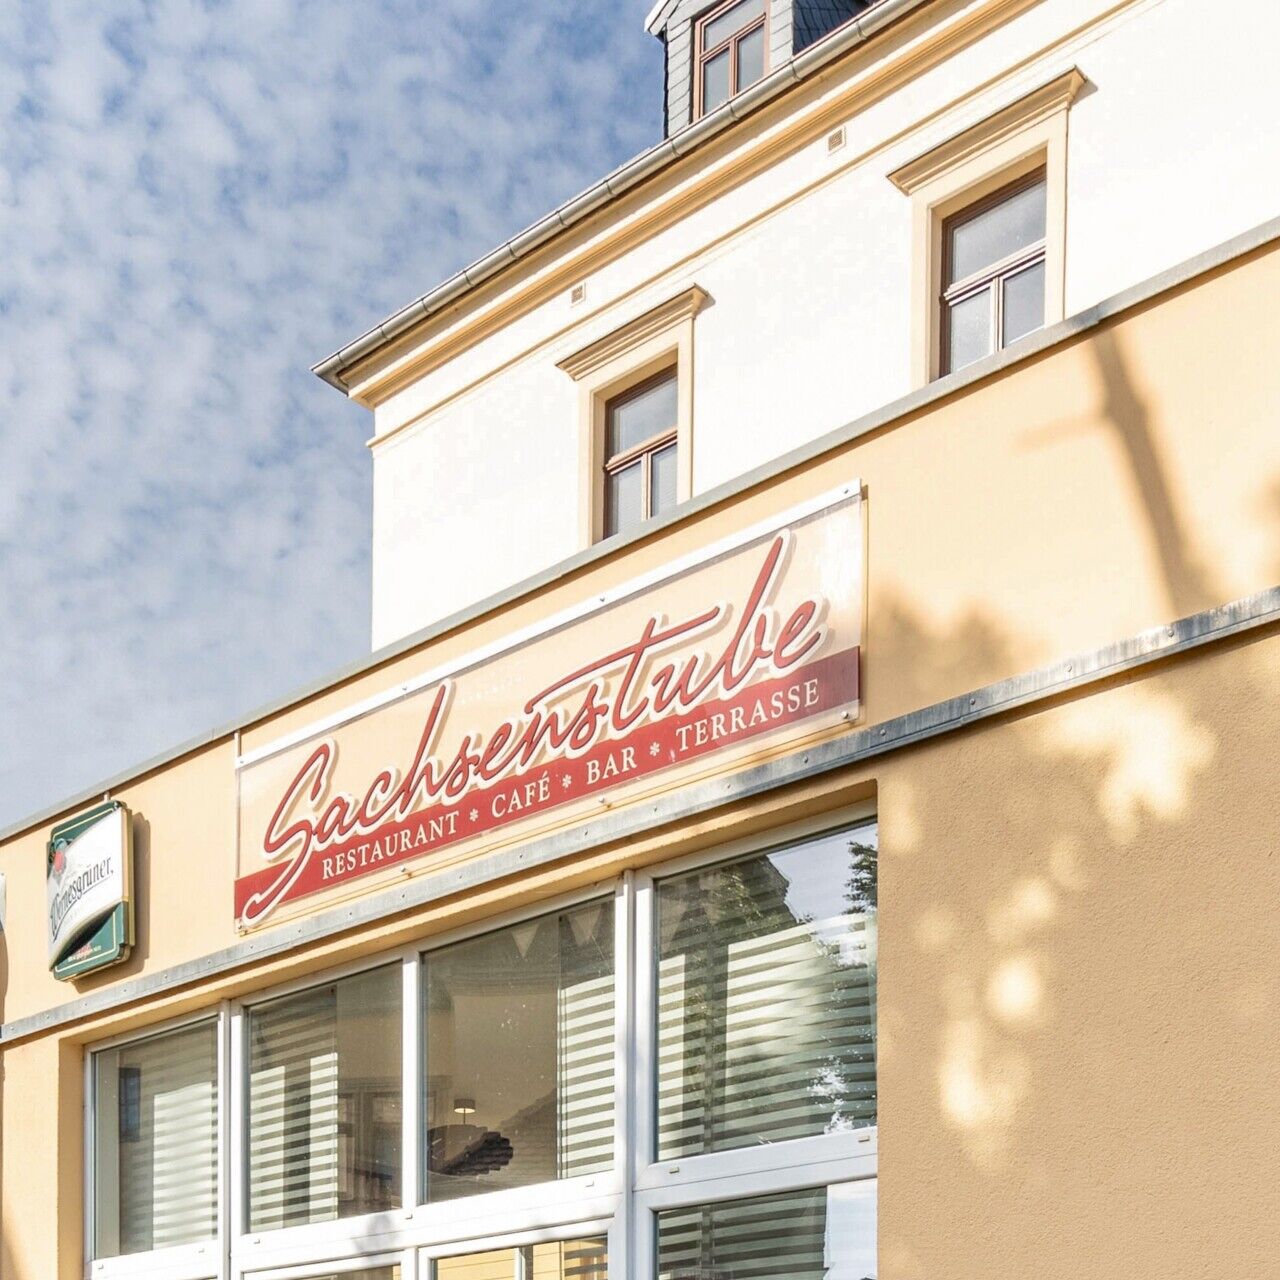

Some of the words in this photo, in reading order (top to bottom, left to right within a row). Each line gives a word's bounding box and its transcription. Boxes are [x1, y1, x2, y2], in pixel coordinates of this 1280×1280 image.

[243, 532, 823, 922] Sachsenstube
[321, 811, 460, 881] RESTAURANT
[491, 770, 551, 819] CAFÉ
[586, 746, 638, 786] BAR
[675, 678, 820, 752] TERRASSE
